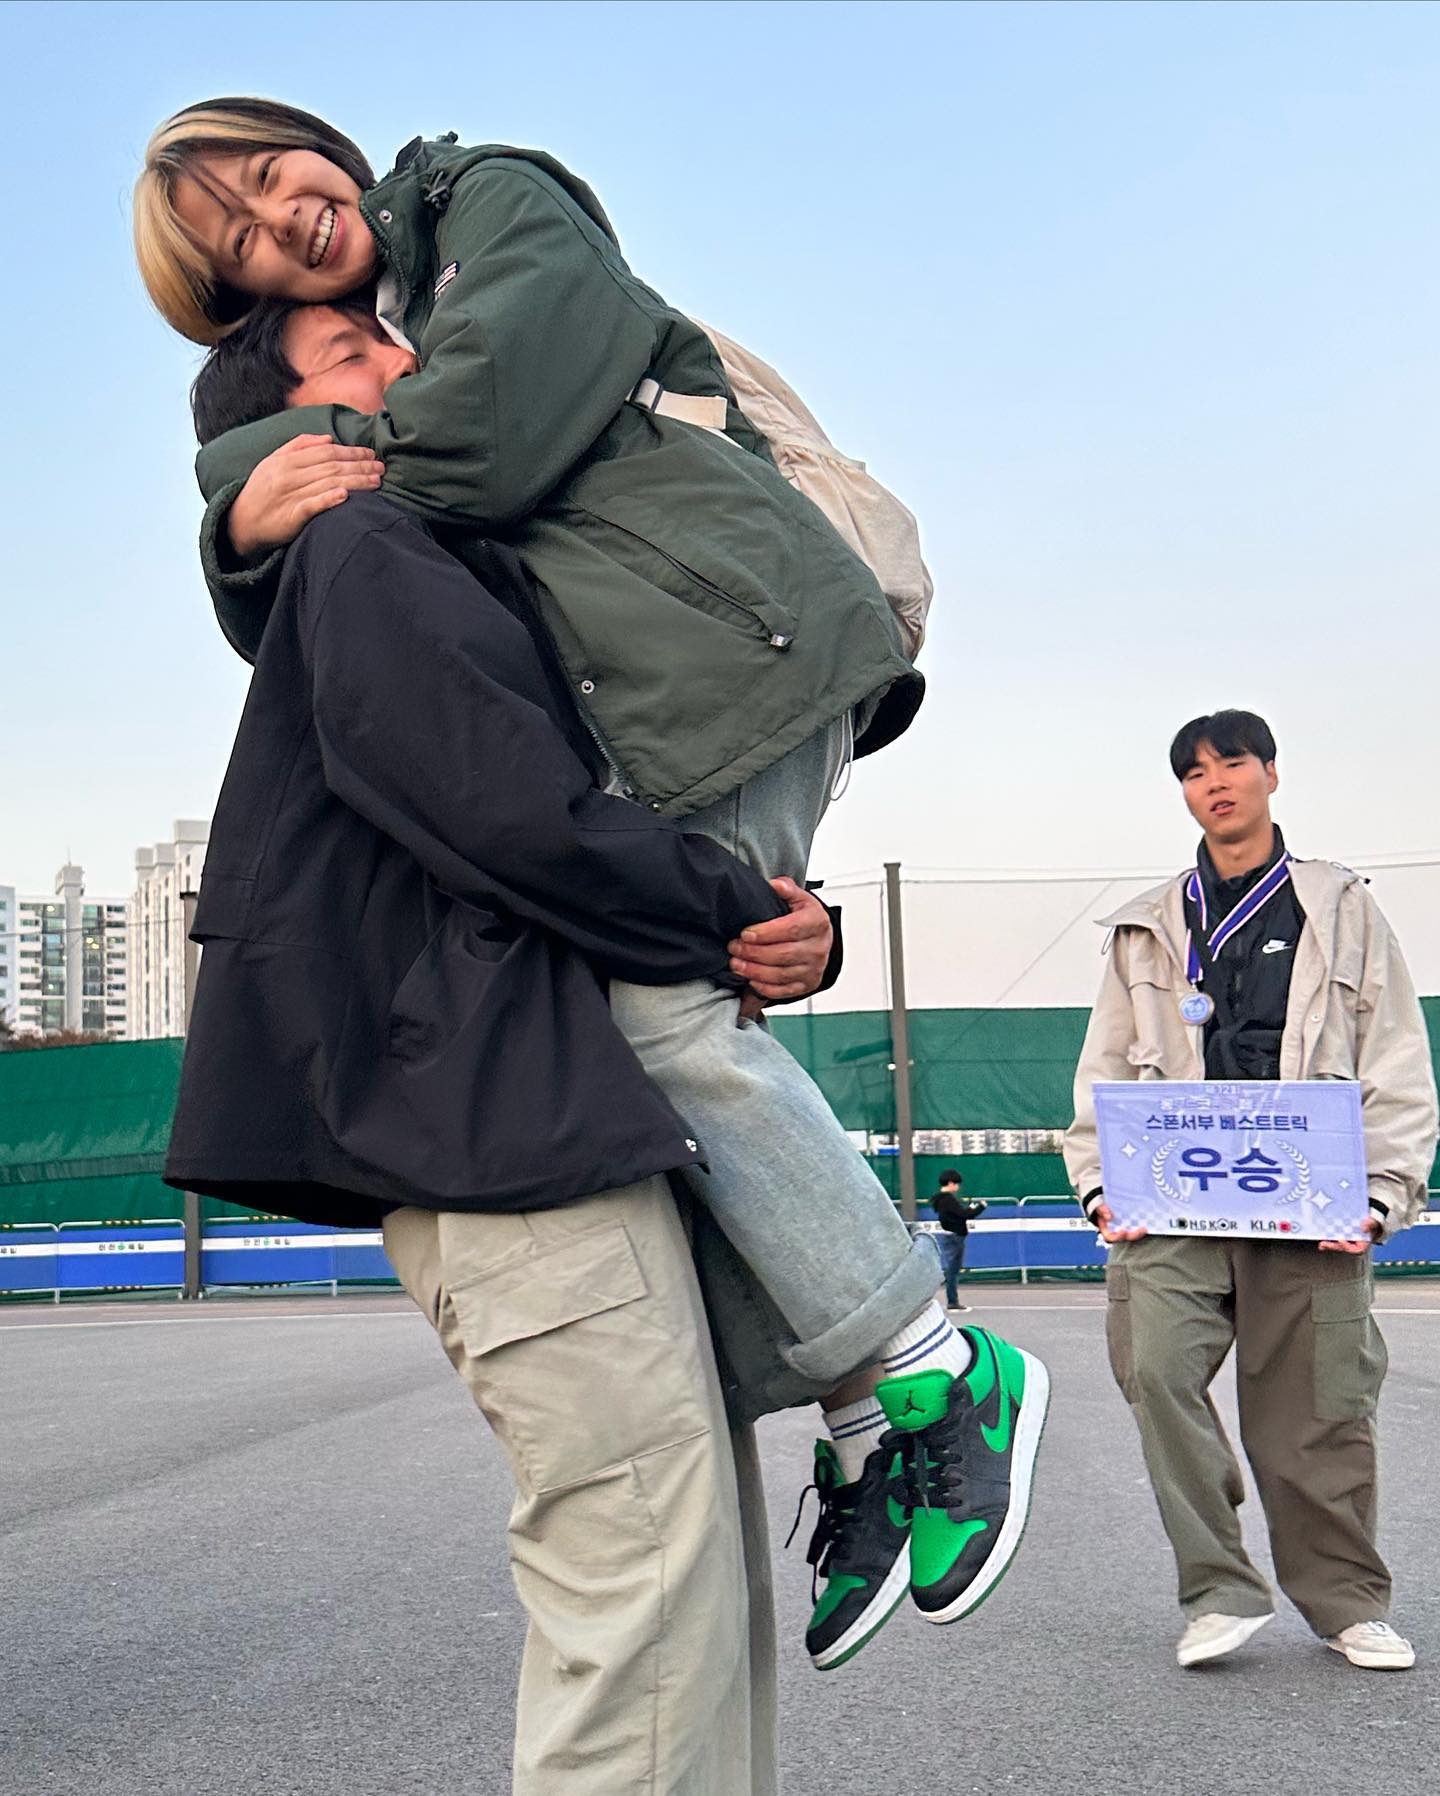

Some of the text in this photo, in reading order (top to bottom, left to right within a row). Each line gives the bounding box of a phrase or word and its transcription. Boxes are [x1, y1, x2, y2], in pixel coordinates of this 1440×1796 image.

[1146, 1115, 1308, 1131] 스폰서부 베스트트릭
[1178, 1147, 1283, 1193] 우승
